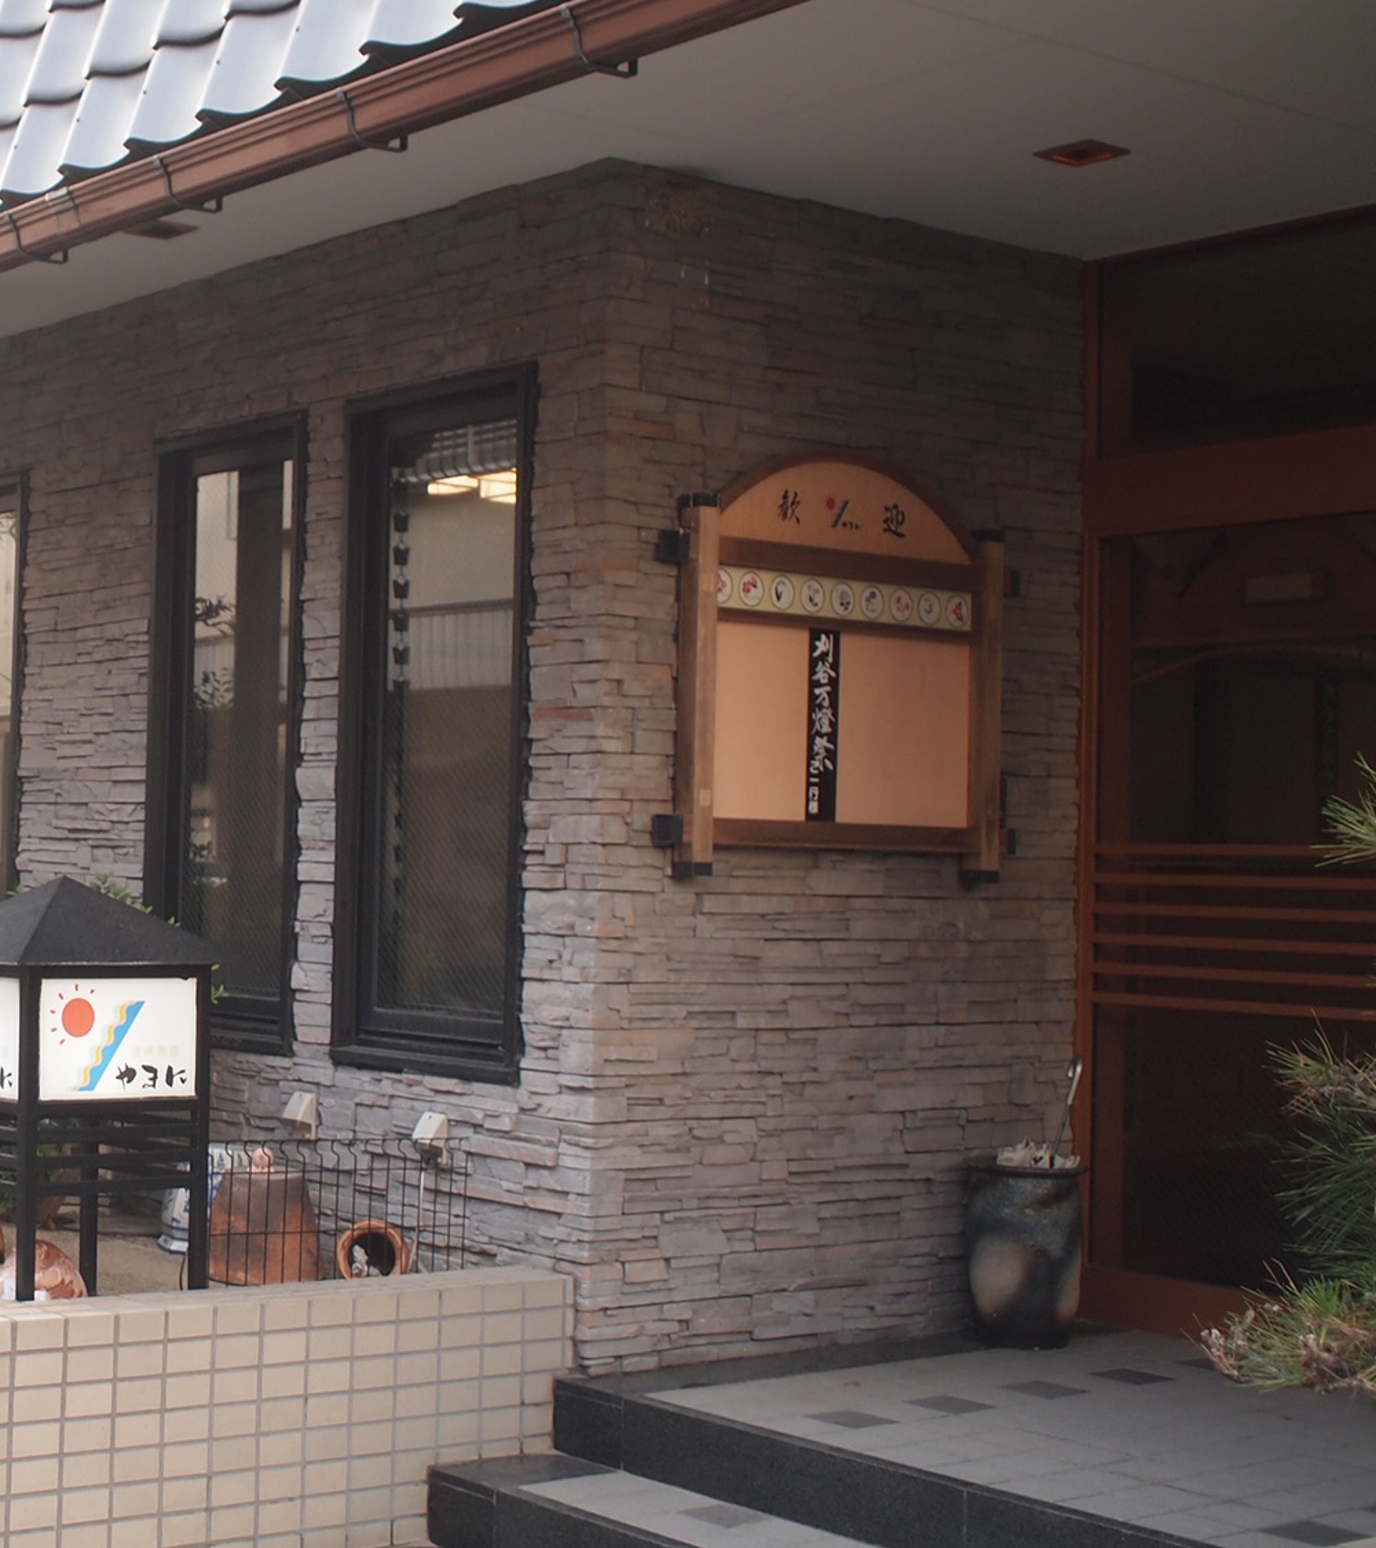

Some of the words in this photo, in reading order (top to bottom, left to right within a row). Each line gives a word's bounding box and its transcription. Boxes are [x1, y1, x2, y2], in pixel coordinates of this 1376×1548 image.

[882, 502, 907, 539] 迎
[115, 1063, 188, 1092] やまに
